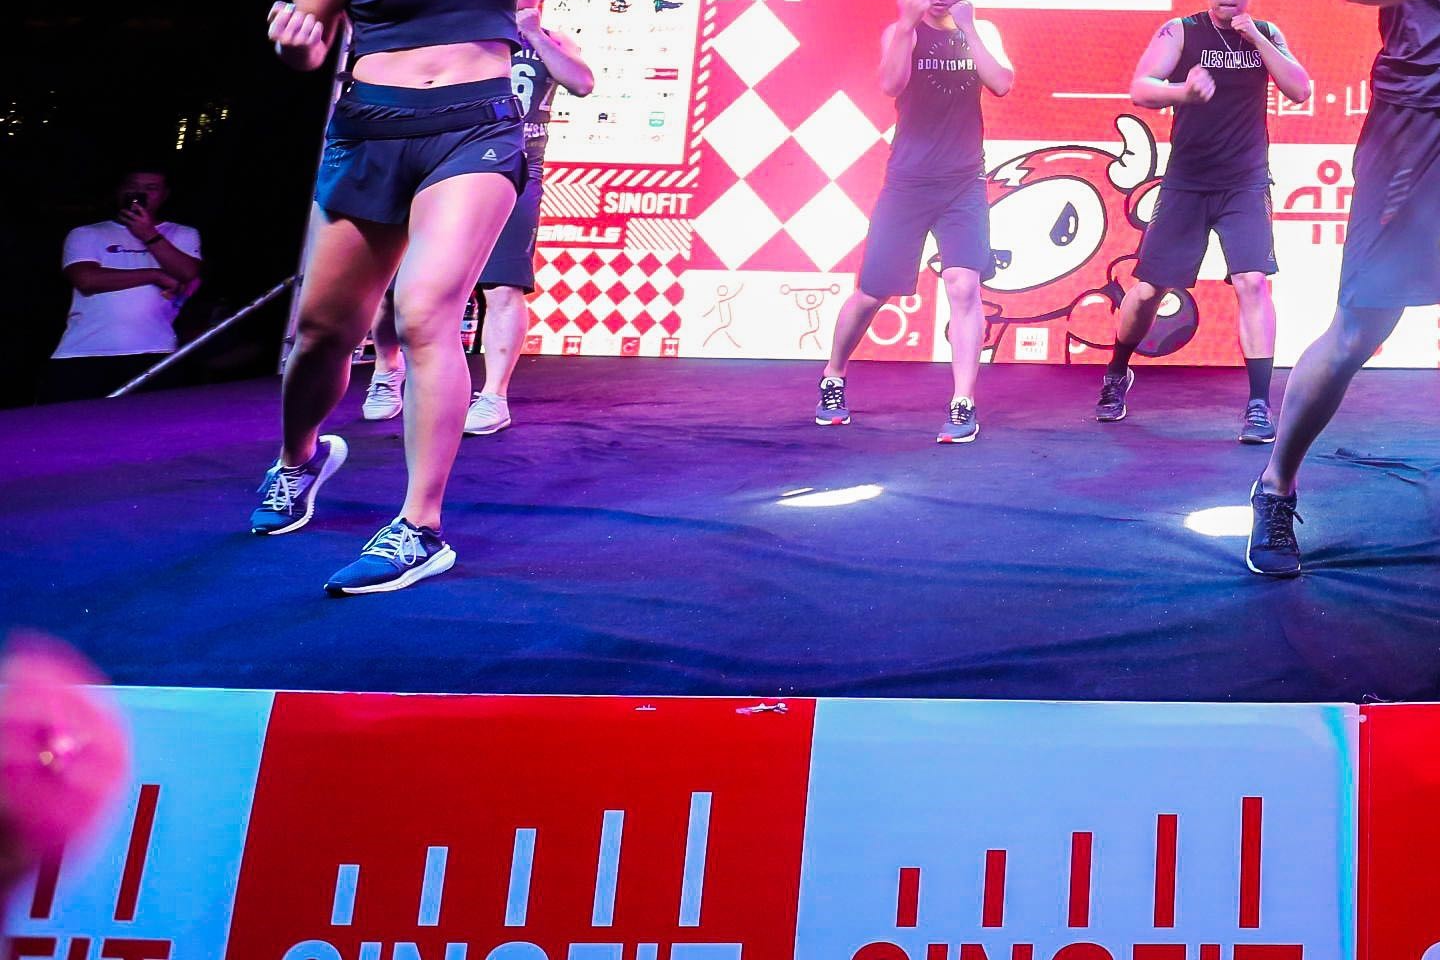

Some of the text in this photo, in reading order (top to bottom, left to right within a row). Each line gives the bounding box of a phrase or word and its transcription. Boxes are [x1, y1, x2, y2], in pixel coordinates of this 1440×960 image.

[918, 59, 977, 71] BODYCOMB
[1201, 50, 1223, 68] LES
[603, 191, 694, 215] SINOFIT
